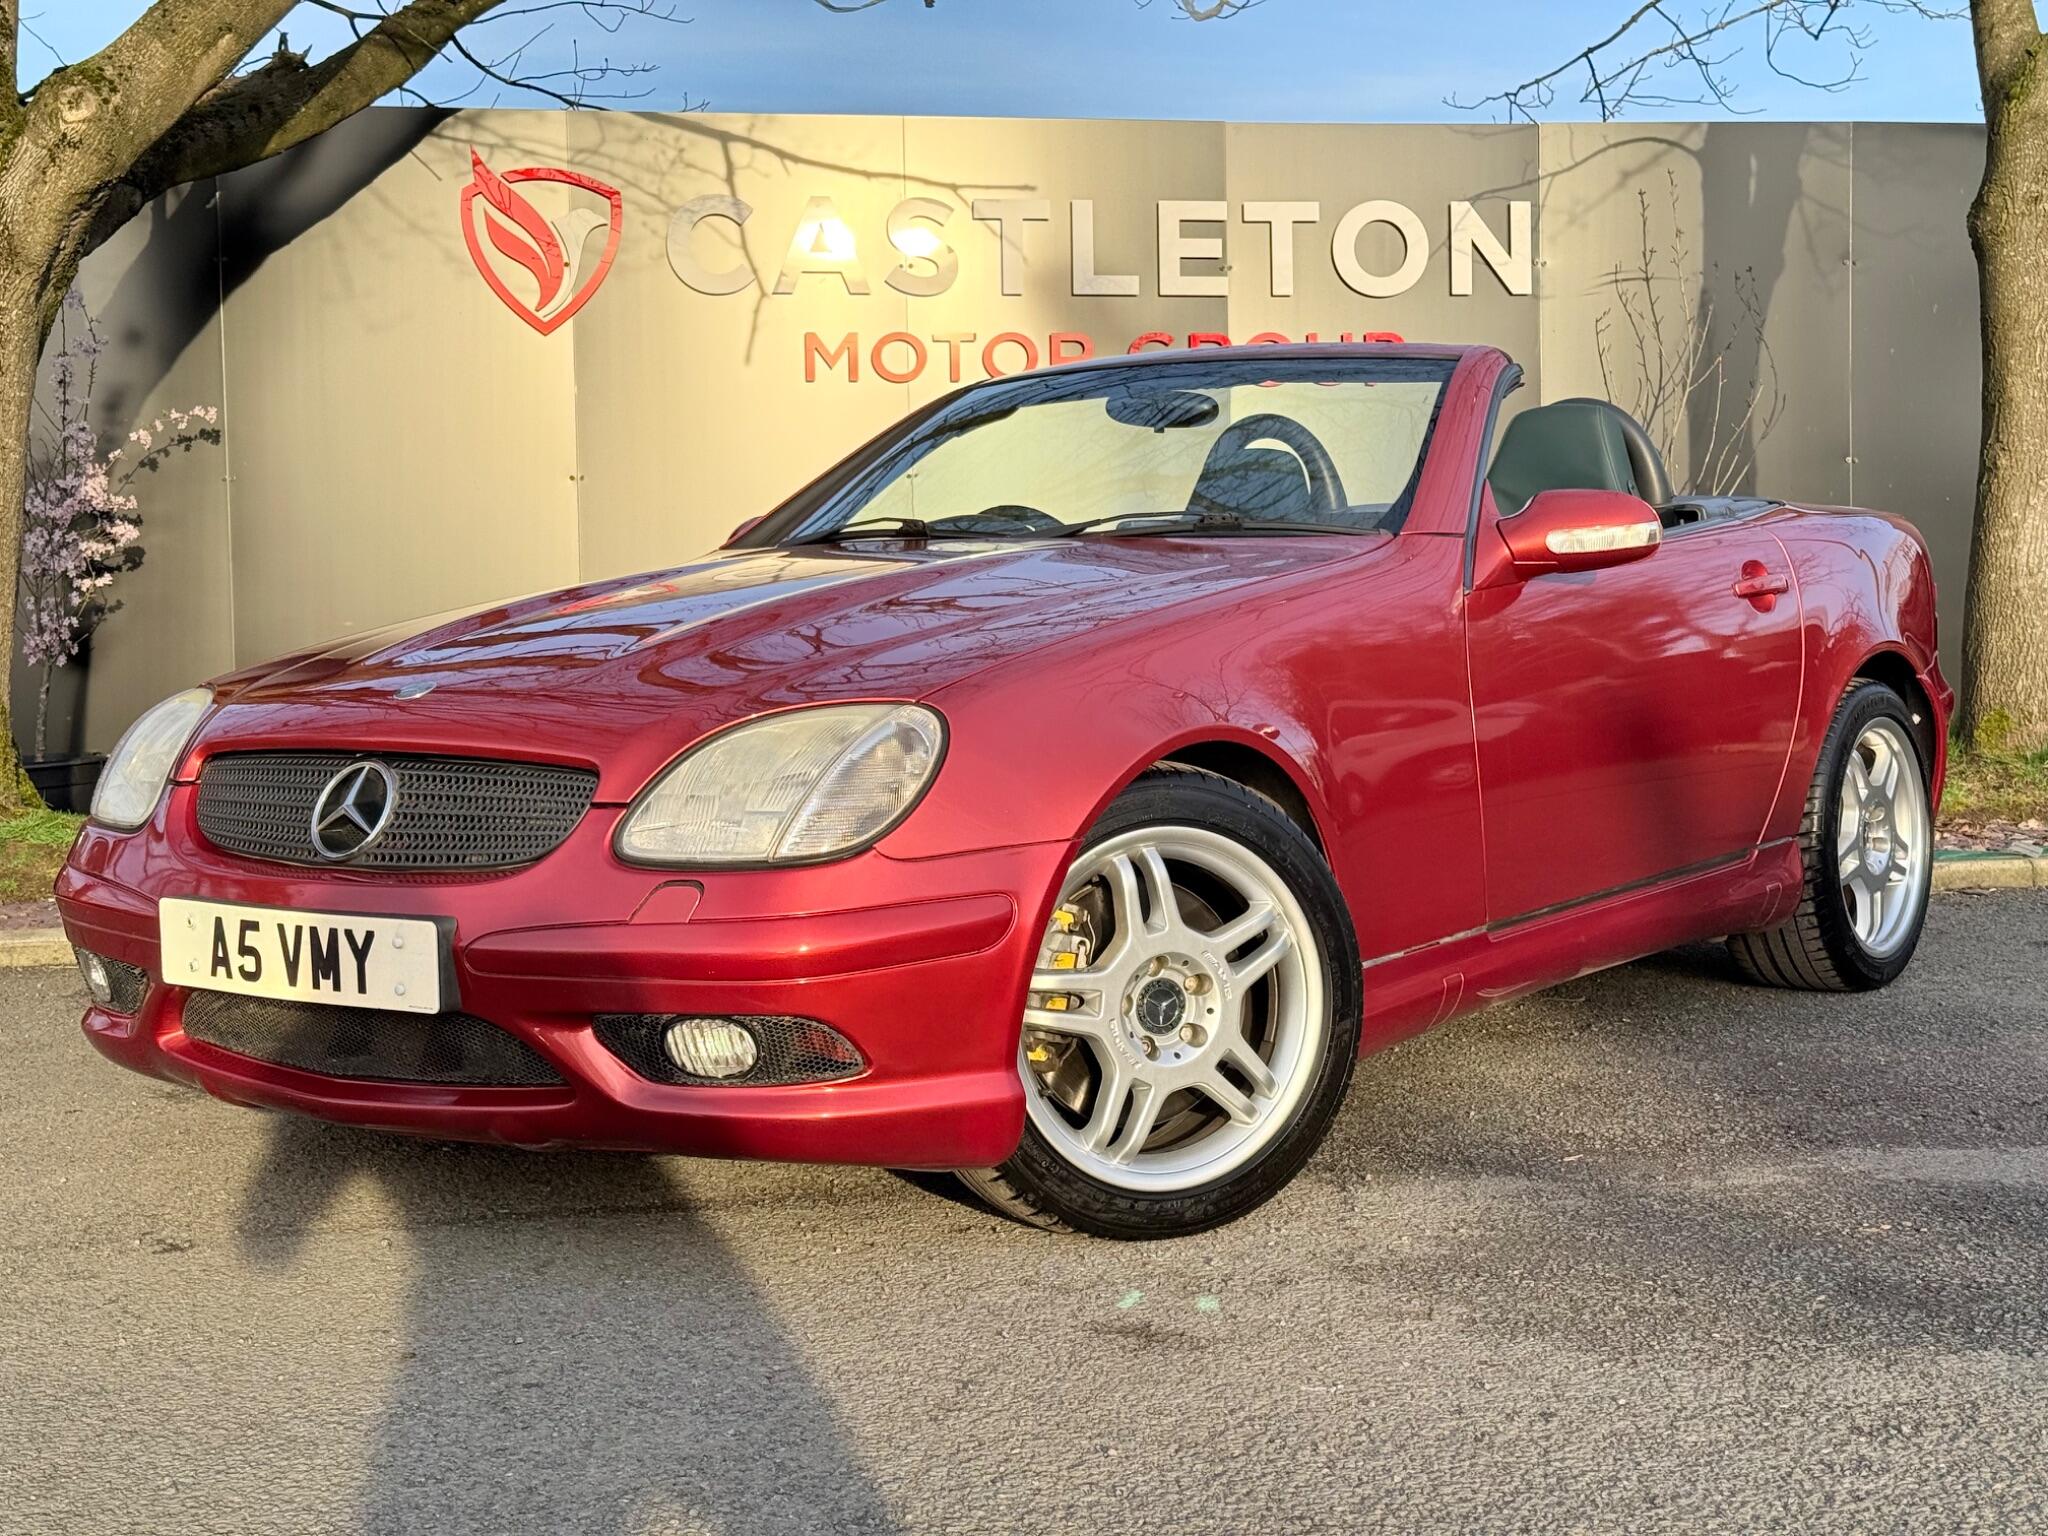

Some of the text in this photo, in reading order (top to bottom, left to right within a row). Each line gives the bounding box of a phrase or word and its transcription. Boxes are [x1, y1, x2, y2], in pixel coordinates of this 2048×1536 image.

[665, 194, 1532, 298] CASTLETON
[210, 916, 375, 995] A5 VMY
